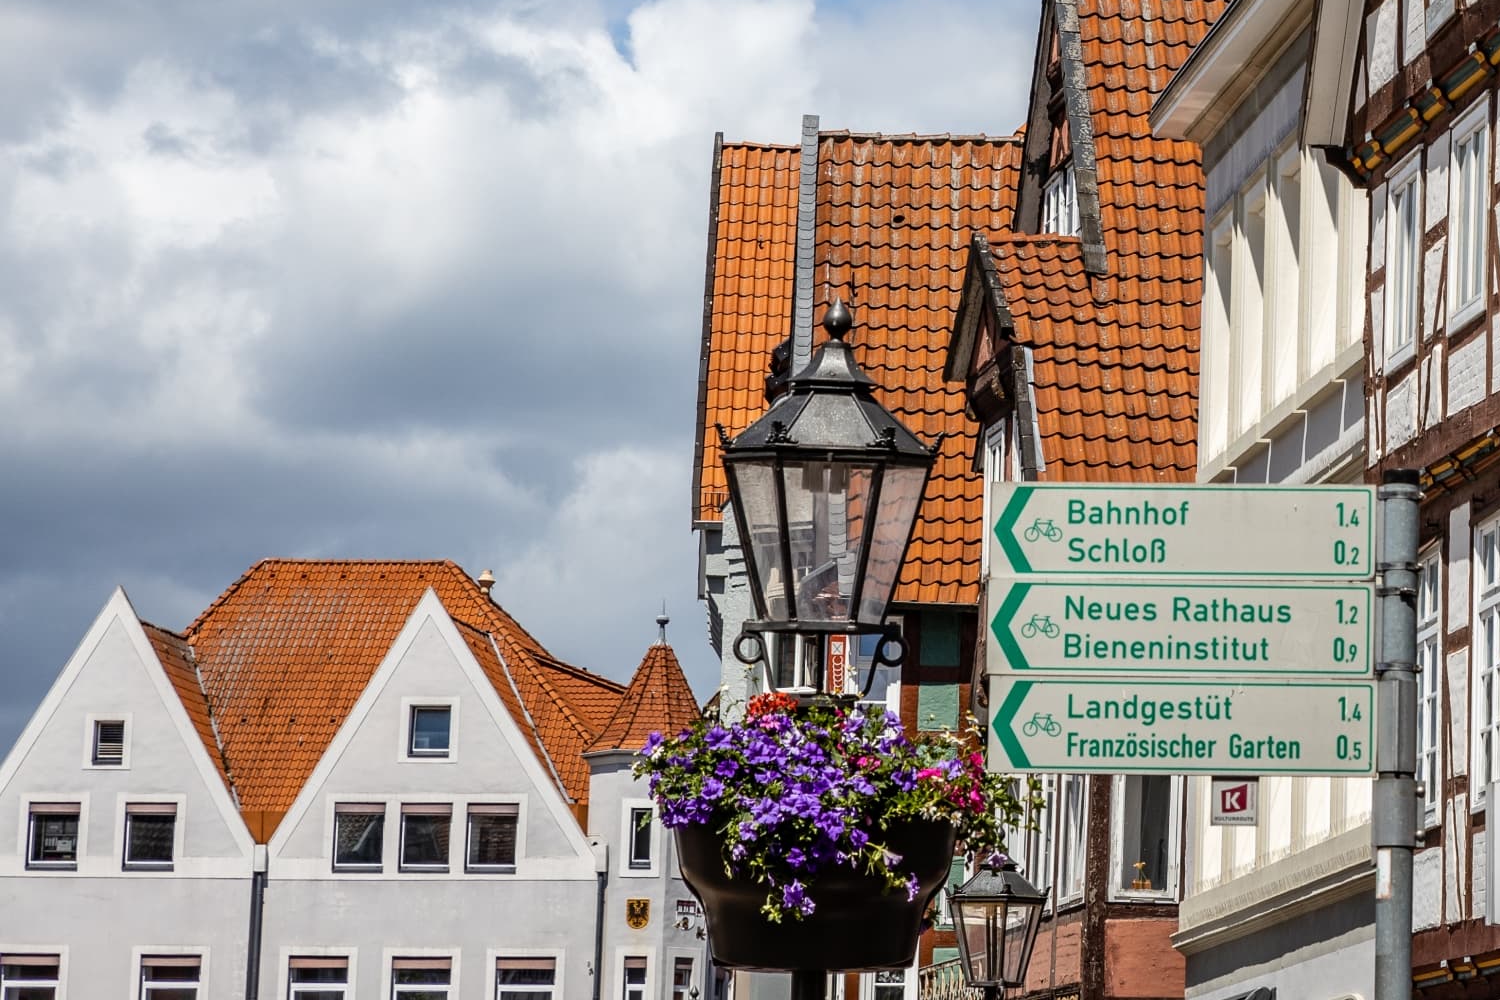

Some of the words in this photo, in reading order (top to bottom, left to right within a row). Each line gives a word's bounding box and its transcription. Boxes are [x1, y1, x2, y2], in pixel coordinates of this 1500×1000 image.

[1068, 499, 1188, 525] Bahnhof
[1337, 503, 1359, 525] 1.4
[1068, 537, 1166, 563] Schloß
[1333, 540, 1359, 565] 0.2
[1064, 596, 1157, 622] Neues
[1173, 596, 1291, 623] Rathaus
[1337, 600, 1357, 624] 1.2
[1064, 633, 1268, 661] Bieneninstitut
[1333, 637, 1357, 662] 0.9
[1068, 695, 1231, 726] Landgestüt
[1339, 697, 1360, 720] 1.4
[1067, 732, 1216, 758] Französischer
[1229, 734, 1300, 759] Garten
[1337, 735, 1360, 760] 0.5
[1225, 791, 1241, 810] K
